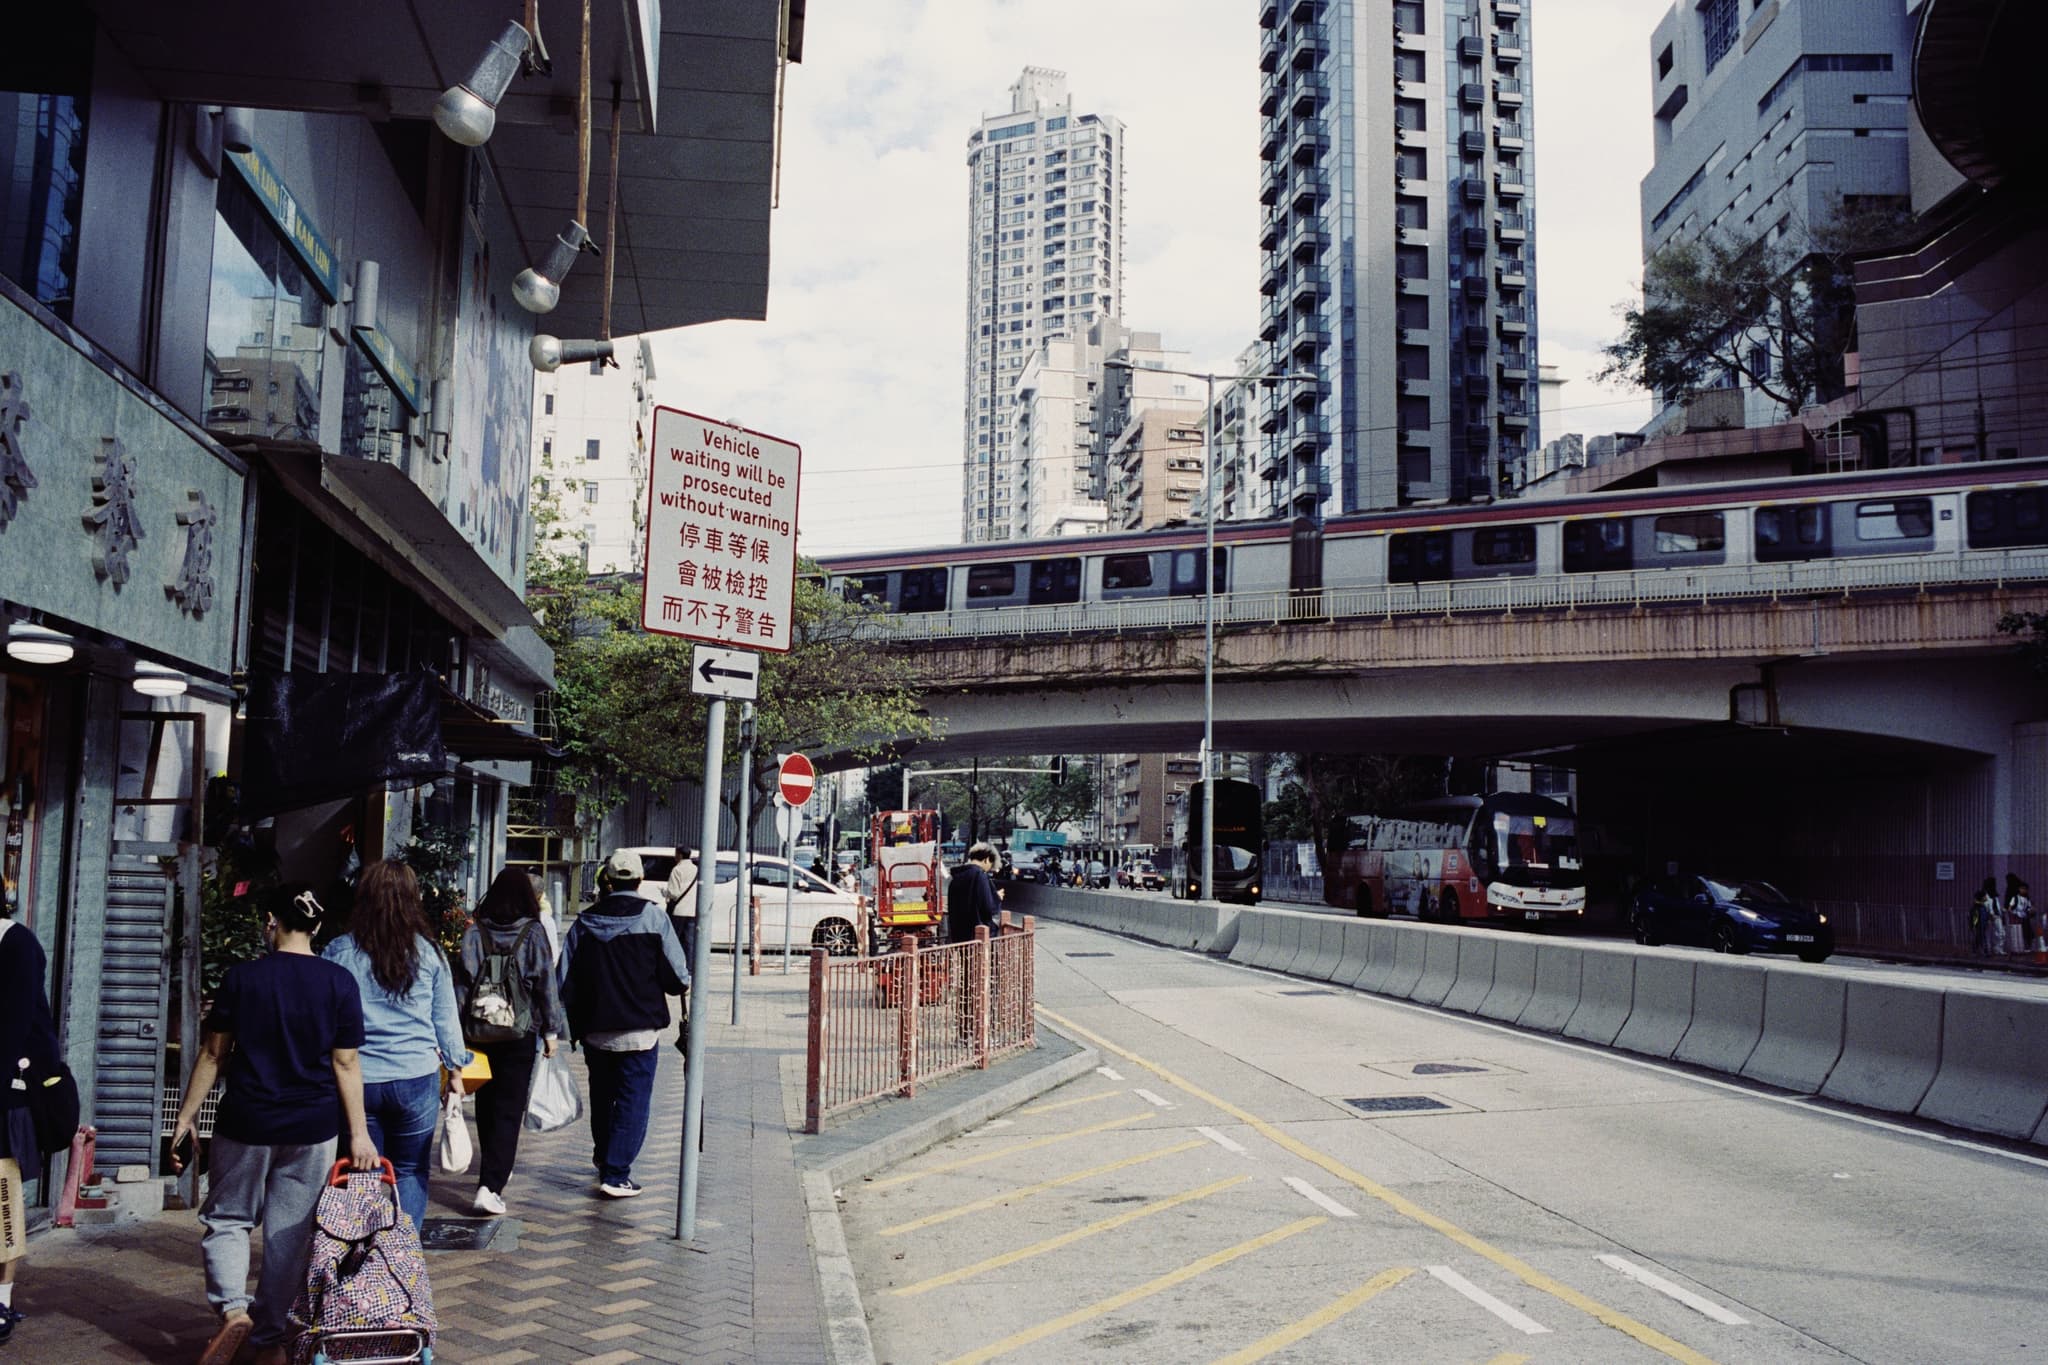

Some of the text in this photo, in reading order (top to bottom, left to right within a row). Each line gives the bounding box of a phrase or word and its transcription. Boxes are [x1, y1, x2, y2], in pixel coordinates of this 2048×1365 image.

[702, 427, 760, 460] Vehicle
[670, 446, 786, 489] waiting will be
[682, 474, 773, 508] prosecuted
[659, 491, 790, 537] without warning
[678, 521, 770, 565] 停車等候
[677, 559, 769, 602] 會被檢控
[662, 595, 777, 639] 而不予警告
